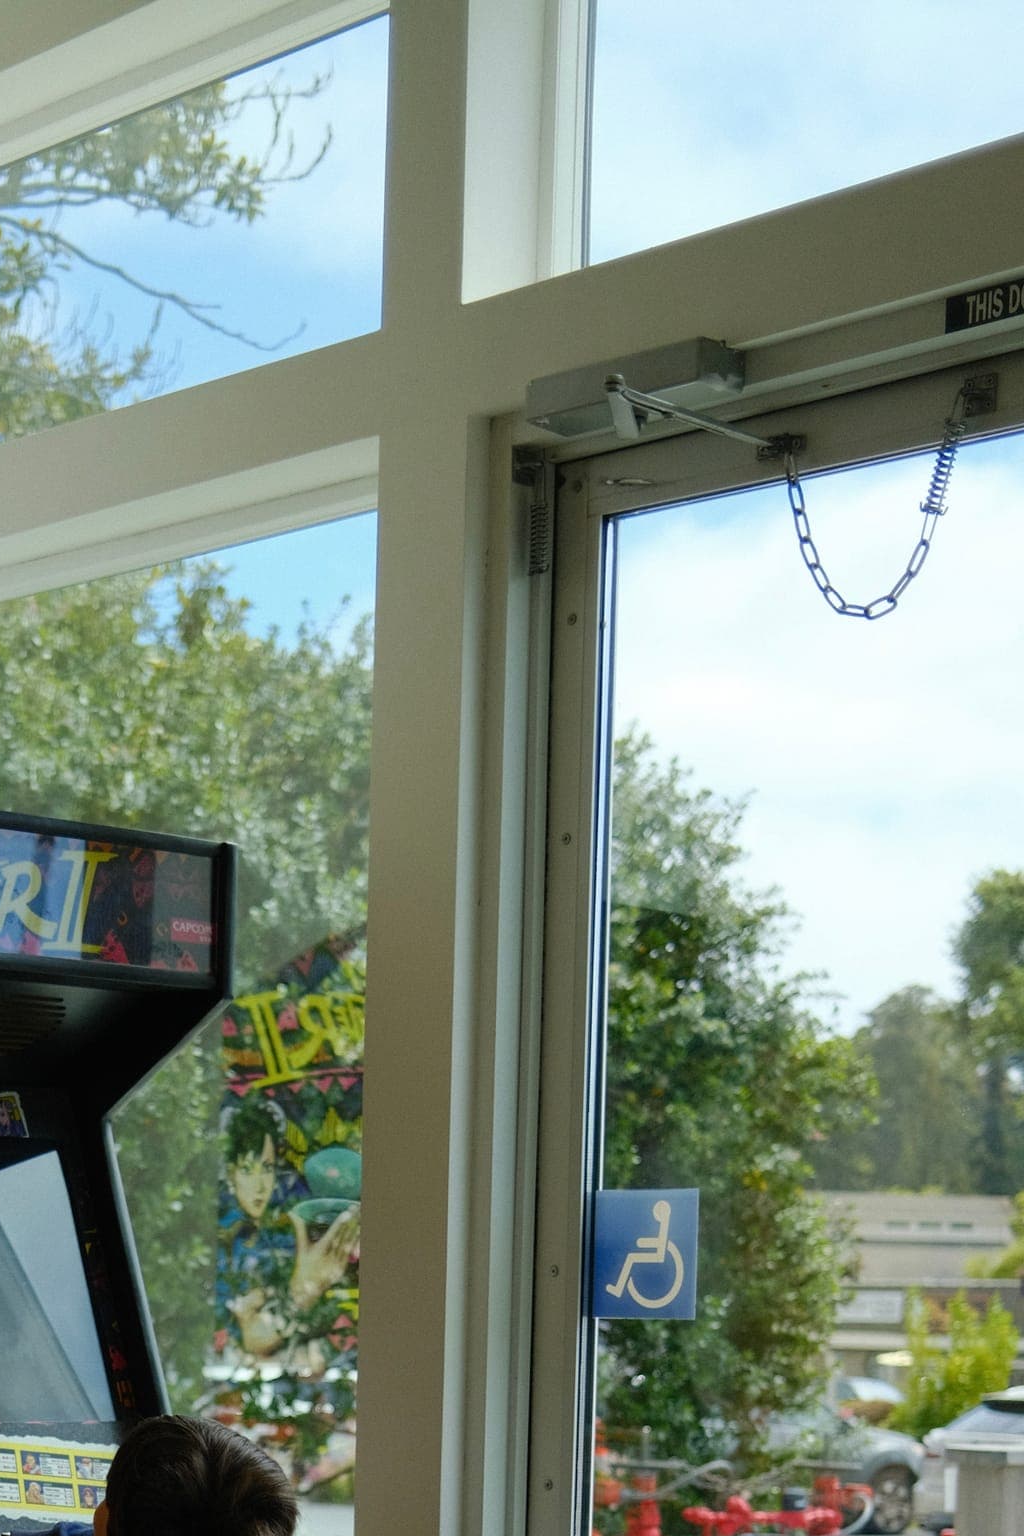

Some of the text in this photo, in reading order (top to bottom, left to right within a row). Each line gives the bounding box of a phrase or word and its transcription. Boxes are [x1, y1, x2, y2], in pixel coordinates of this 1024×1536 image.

[966, 283, 1024, 325] THIS D
[41, 849, 118, 954] II
